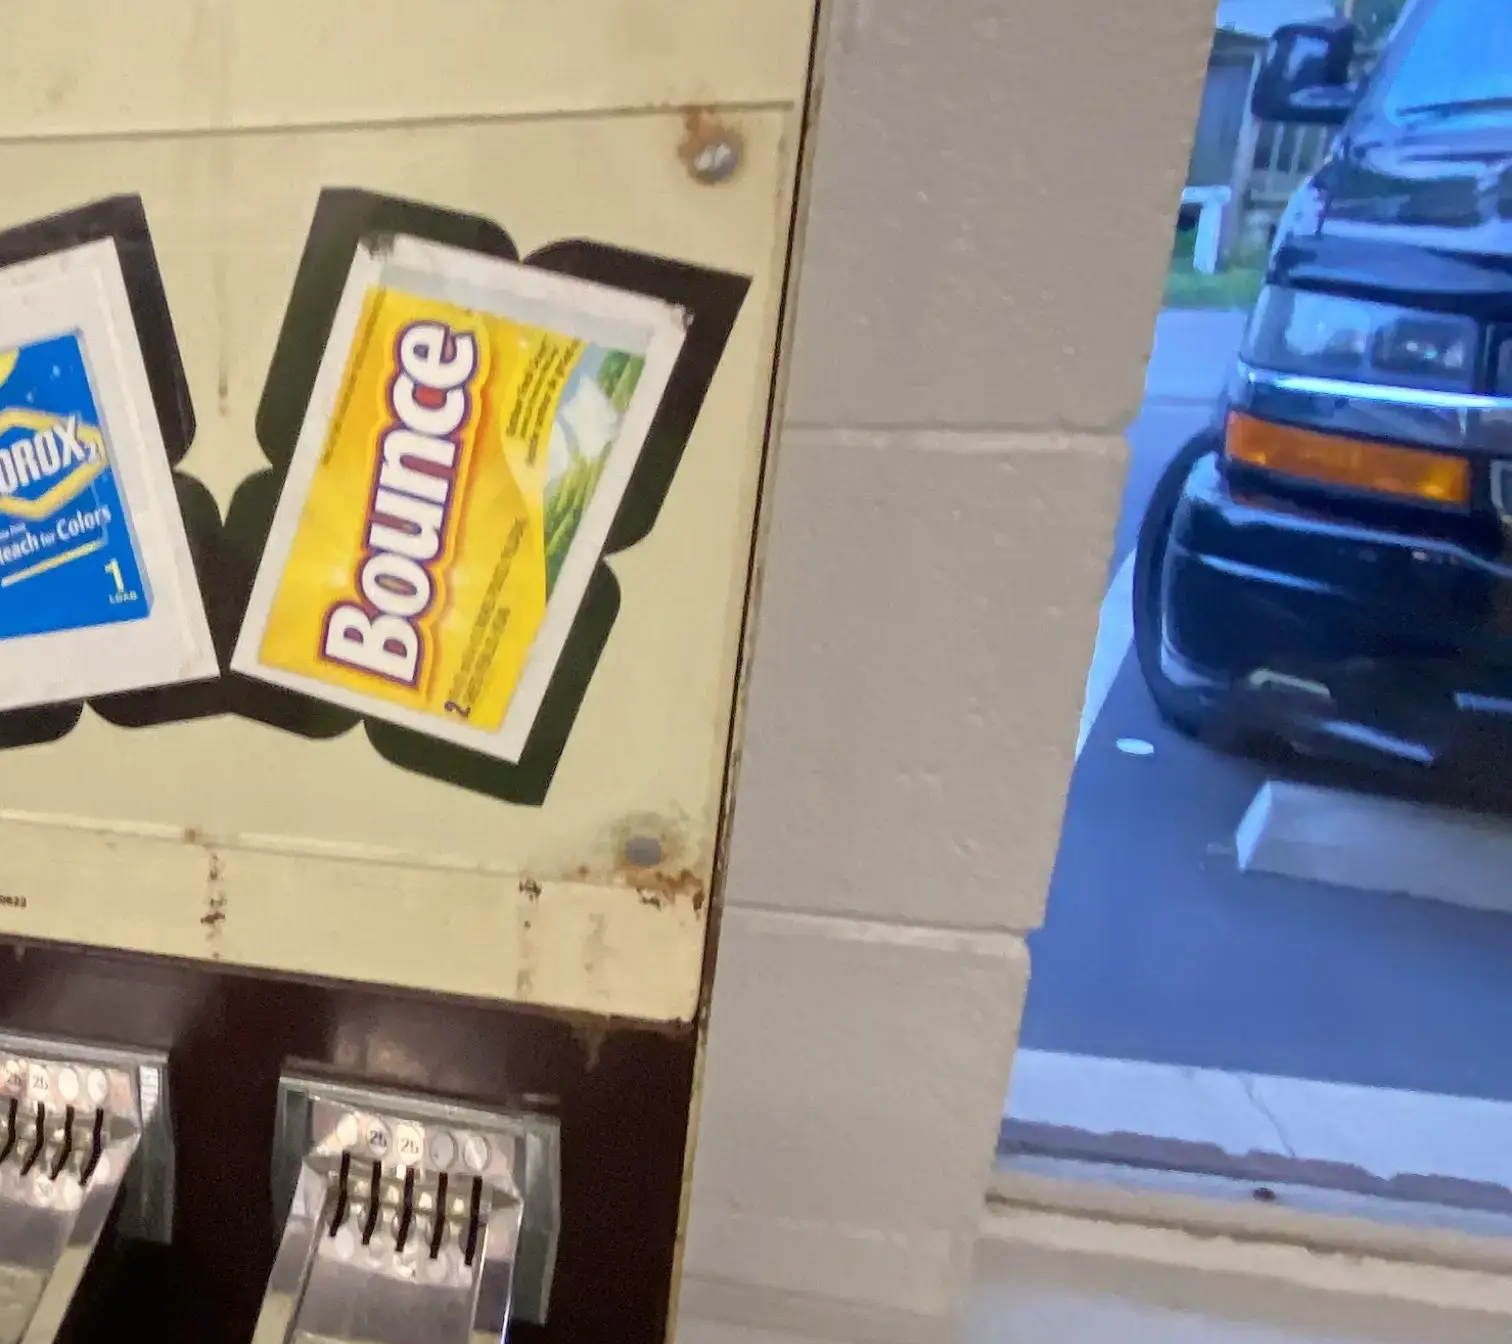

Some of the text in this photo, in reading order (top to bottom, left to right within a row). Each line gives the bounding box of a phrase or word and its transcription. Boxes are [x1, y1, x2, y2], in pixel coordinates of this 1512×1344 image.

[317, 318, 480, 688] Bounce
[56, 504, 112, 541] Colors
[104, 557, 125, 593] 1
